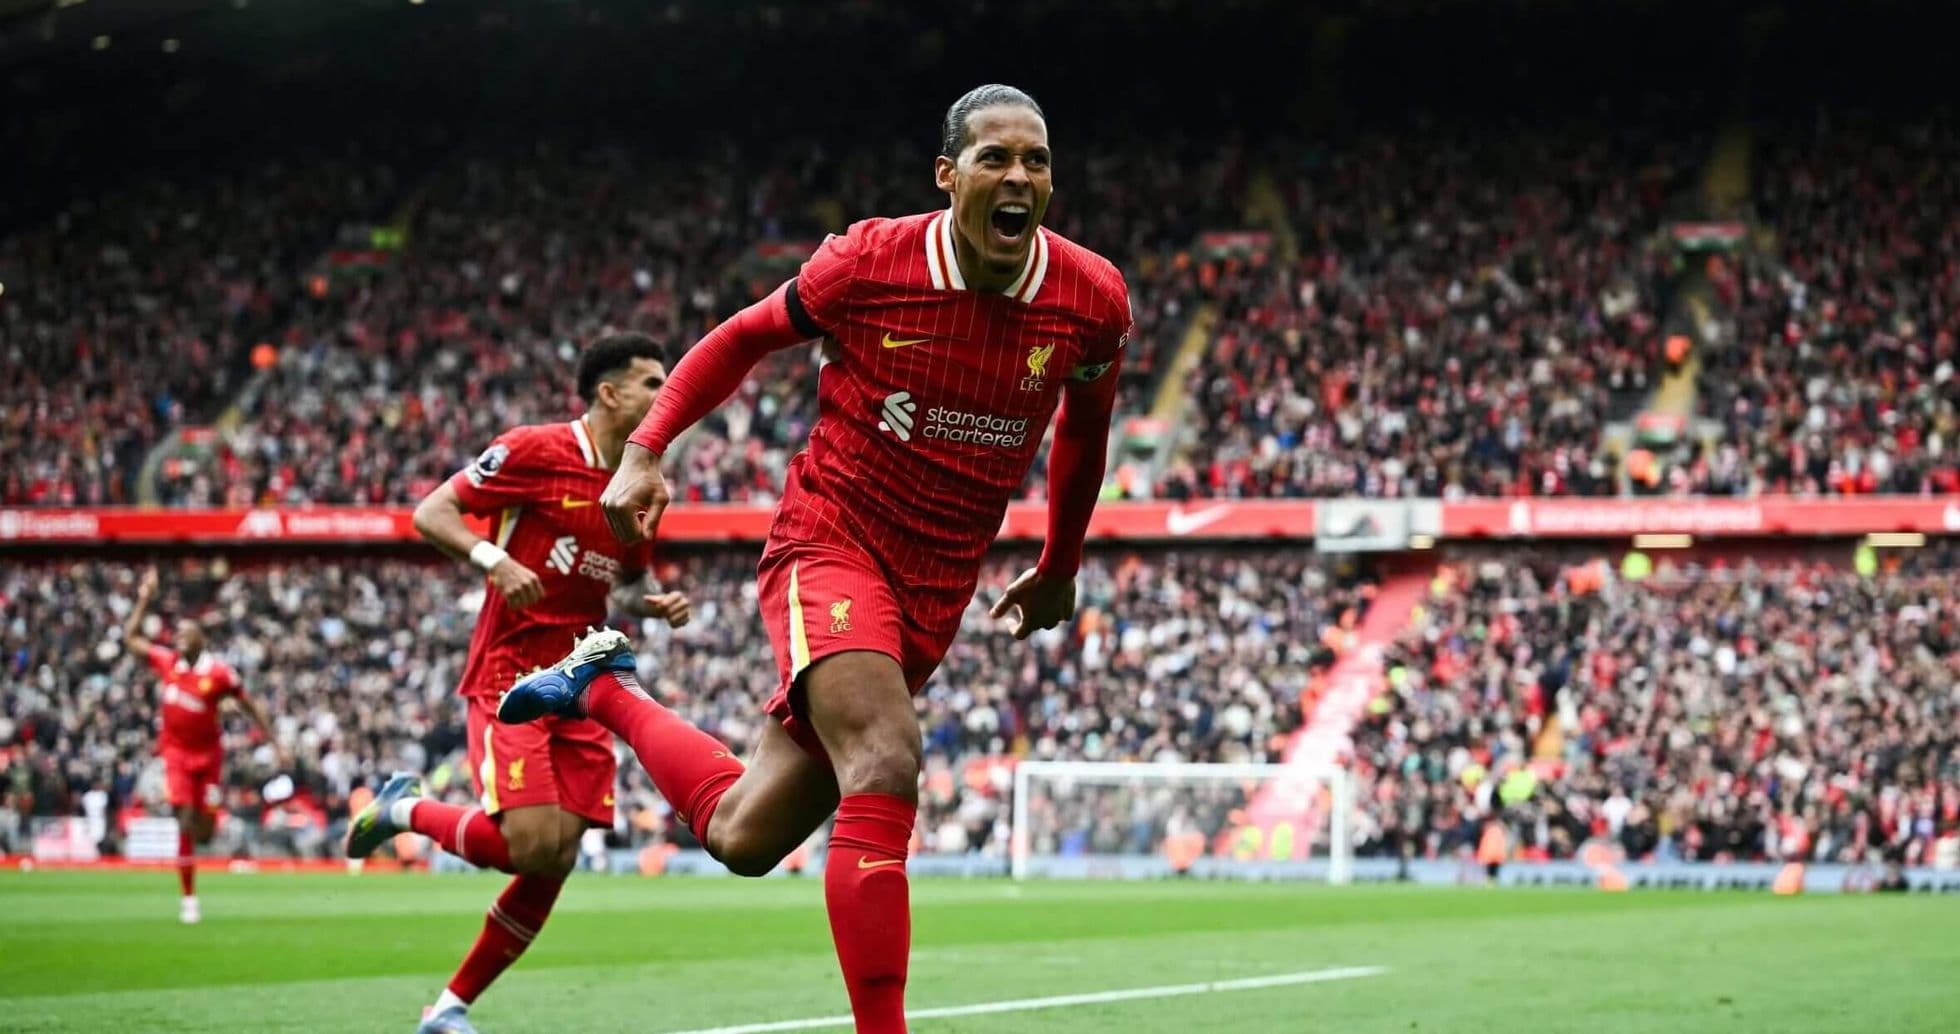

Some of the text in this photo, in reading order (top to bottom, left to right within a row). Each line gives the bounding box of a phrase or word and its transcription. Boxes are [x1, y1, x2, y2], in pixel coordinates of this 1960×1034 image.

[1020, 380, 1043, 391] LFC
[926, 406, 1027, 432] standard
[923, 424, 1027, 447] chartered
